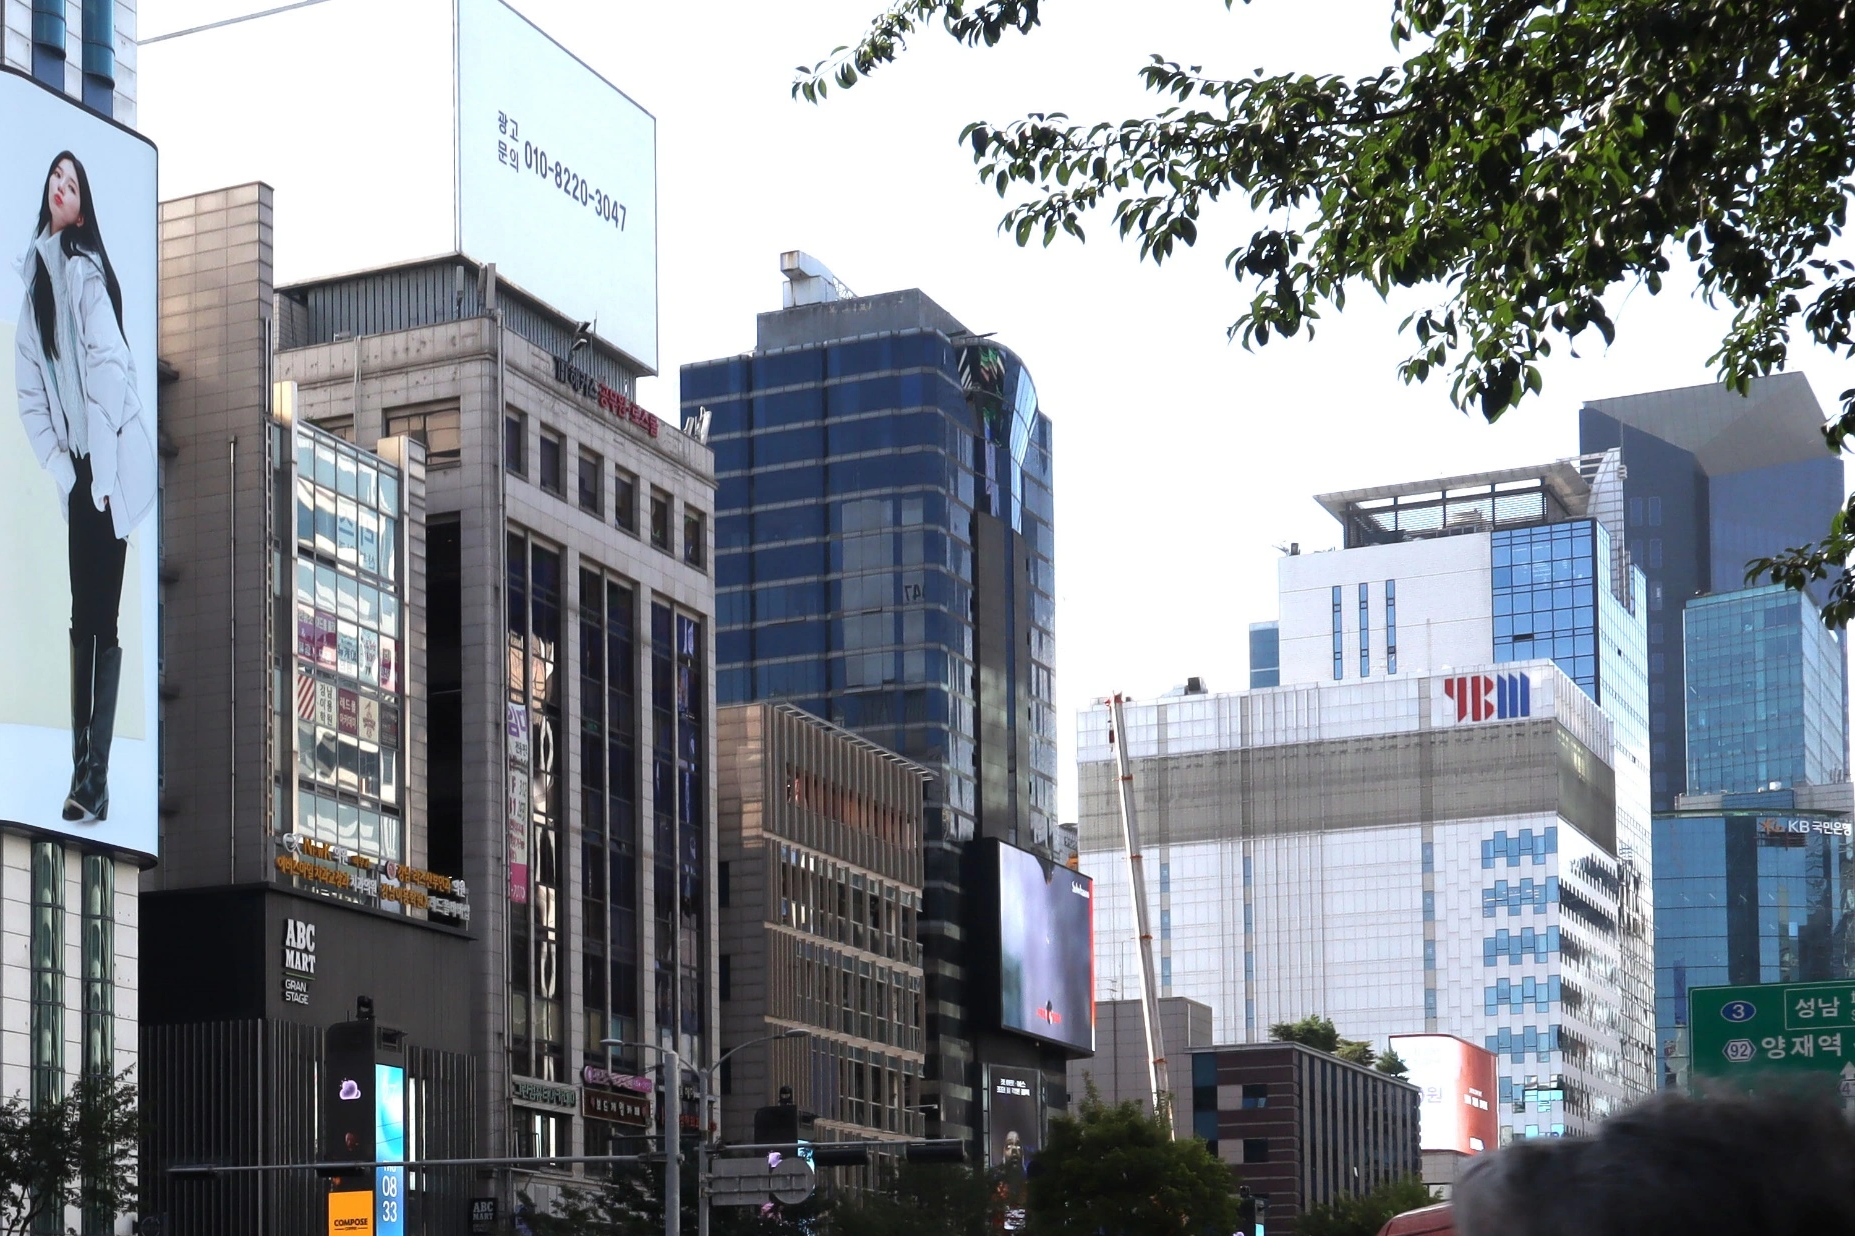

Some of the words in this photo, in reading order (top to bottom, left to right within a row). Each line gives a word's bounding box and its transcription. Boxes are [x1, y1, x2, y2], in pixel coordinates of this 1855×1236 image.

[498, 110, 519, 142] 광고
[498, 139, 519, 173] 문의
[524, 140, 627, 232] 010-8220-3047
[1444, 671, 1531, 723] YBM
[1788, 820, 1810, 834] KB
[1812, 820, 1853, 837] 국민은행
[285, 918, 316, 952] ABC
[285, 949, 316, 974] MART
[285, 979, 307, 992] GRAN
[285, 991, 309, 1005] STAGE
[1794, 996, 1840, 1019] 성남
[1732, 1003, 1746, 1019] 3
[1730, 1042, 1749, 1058] 92
[1761, 1032, 1843, 1060] 양재역
[382, 1176, 397, 1198] 08
[382, 1201, 397, 1222] 33
[473, 1201, 494, 1212] ABC
[334, 1217, 368, 1227] COMPOSE
